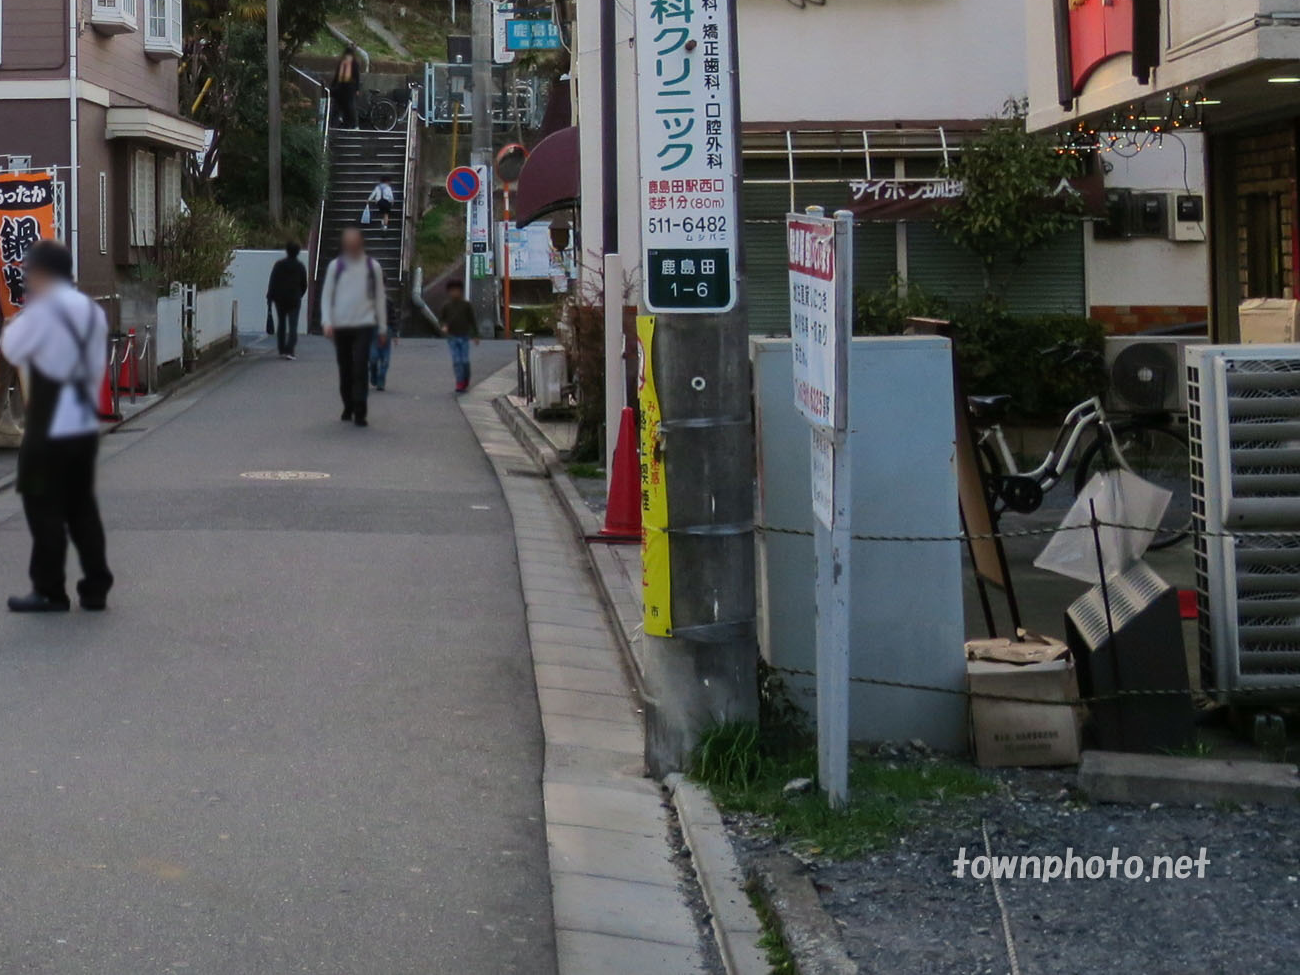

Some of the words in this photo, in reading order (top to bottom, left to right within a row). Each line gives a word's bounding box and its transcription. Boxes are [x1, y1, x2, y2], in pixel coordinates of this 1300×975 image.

[648, 178, 724, 194] 鹿島田駅西口
[648, 216, 727, 234] 511-6482
[661, 258, 716, 275] 鹿島田
[670, 282, 709, 298] 1-6
